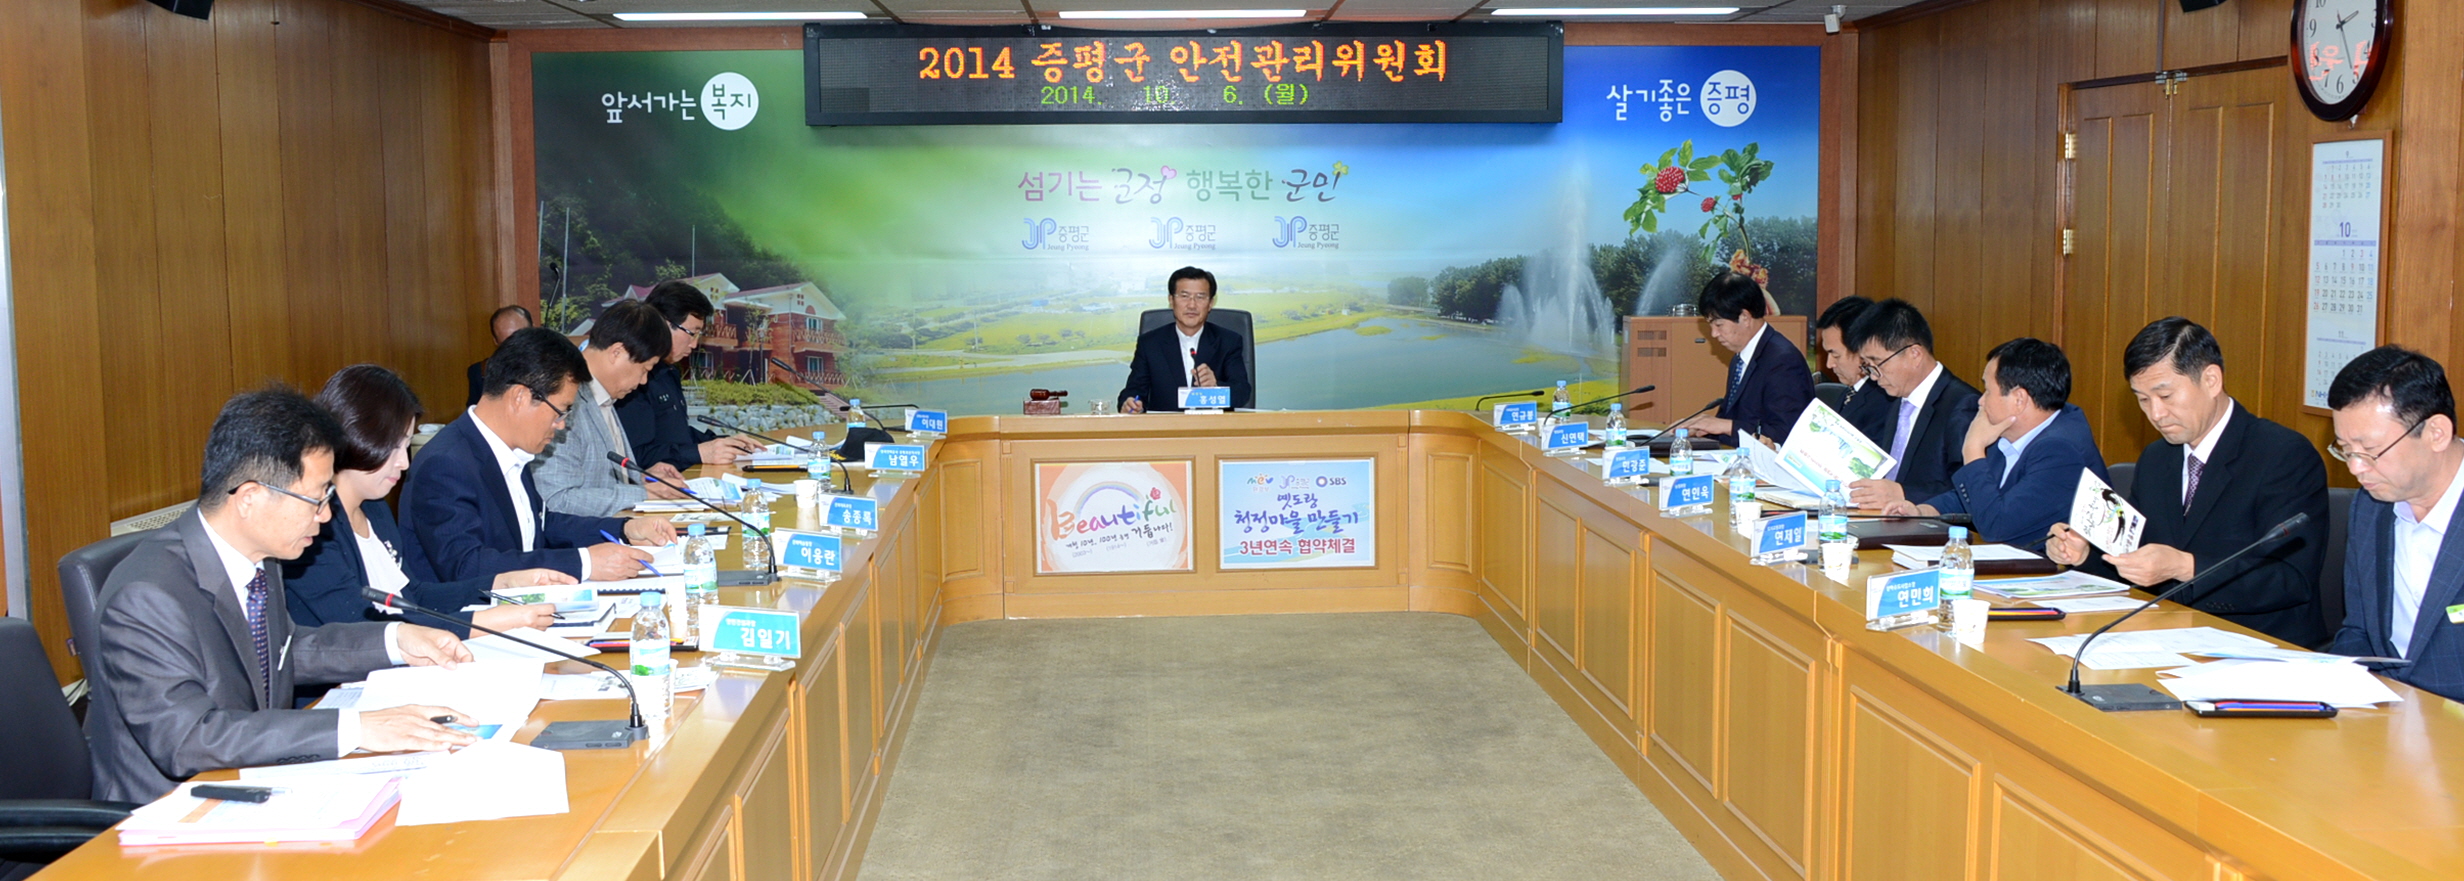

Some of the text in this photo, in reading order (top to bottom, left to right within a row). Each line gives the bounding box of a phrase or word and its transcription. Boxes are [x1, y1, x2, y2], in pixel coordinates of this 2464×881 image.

[2309, 18, 2317, 38] 9
[919, 40, 1447, 83] 2014 증평군 안전관리위원회
[1041, 85, 1103, 105] 2014.
[1223, 85, 1244, 105] 6.
[1263, 83, 1309, 105] (월)
[2336, 74, 2344, 94] 6
[601, 84, 751, 123] 앞서가는 복지
[1606, 79, 1750, 122] 살기좋은 증평
[1018, 167, 1341, 204] 섬기는 군정 행복한 군민
[1058, 225, 1090, 243] 증평군
[1185, 224, 1216, 242] 증평군
[1308, 223, 1340, 241] 증평군
[2339, 221, 2351, 238] 10
[1329, 477, 1347, 486] SBS
[1277, 493, 1318, 510] 옛도랑
[1046, 495, 1177, 541] Beautiful
[1234, 510, 1359, 535] 청정마을 만들기
[1240, 538, 1355, 555] 3년연속 협약체결
[1897, 585, 1935, 608] 연민희
[740, 627, 791, 650] 김일기
